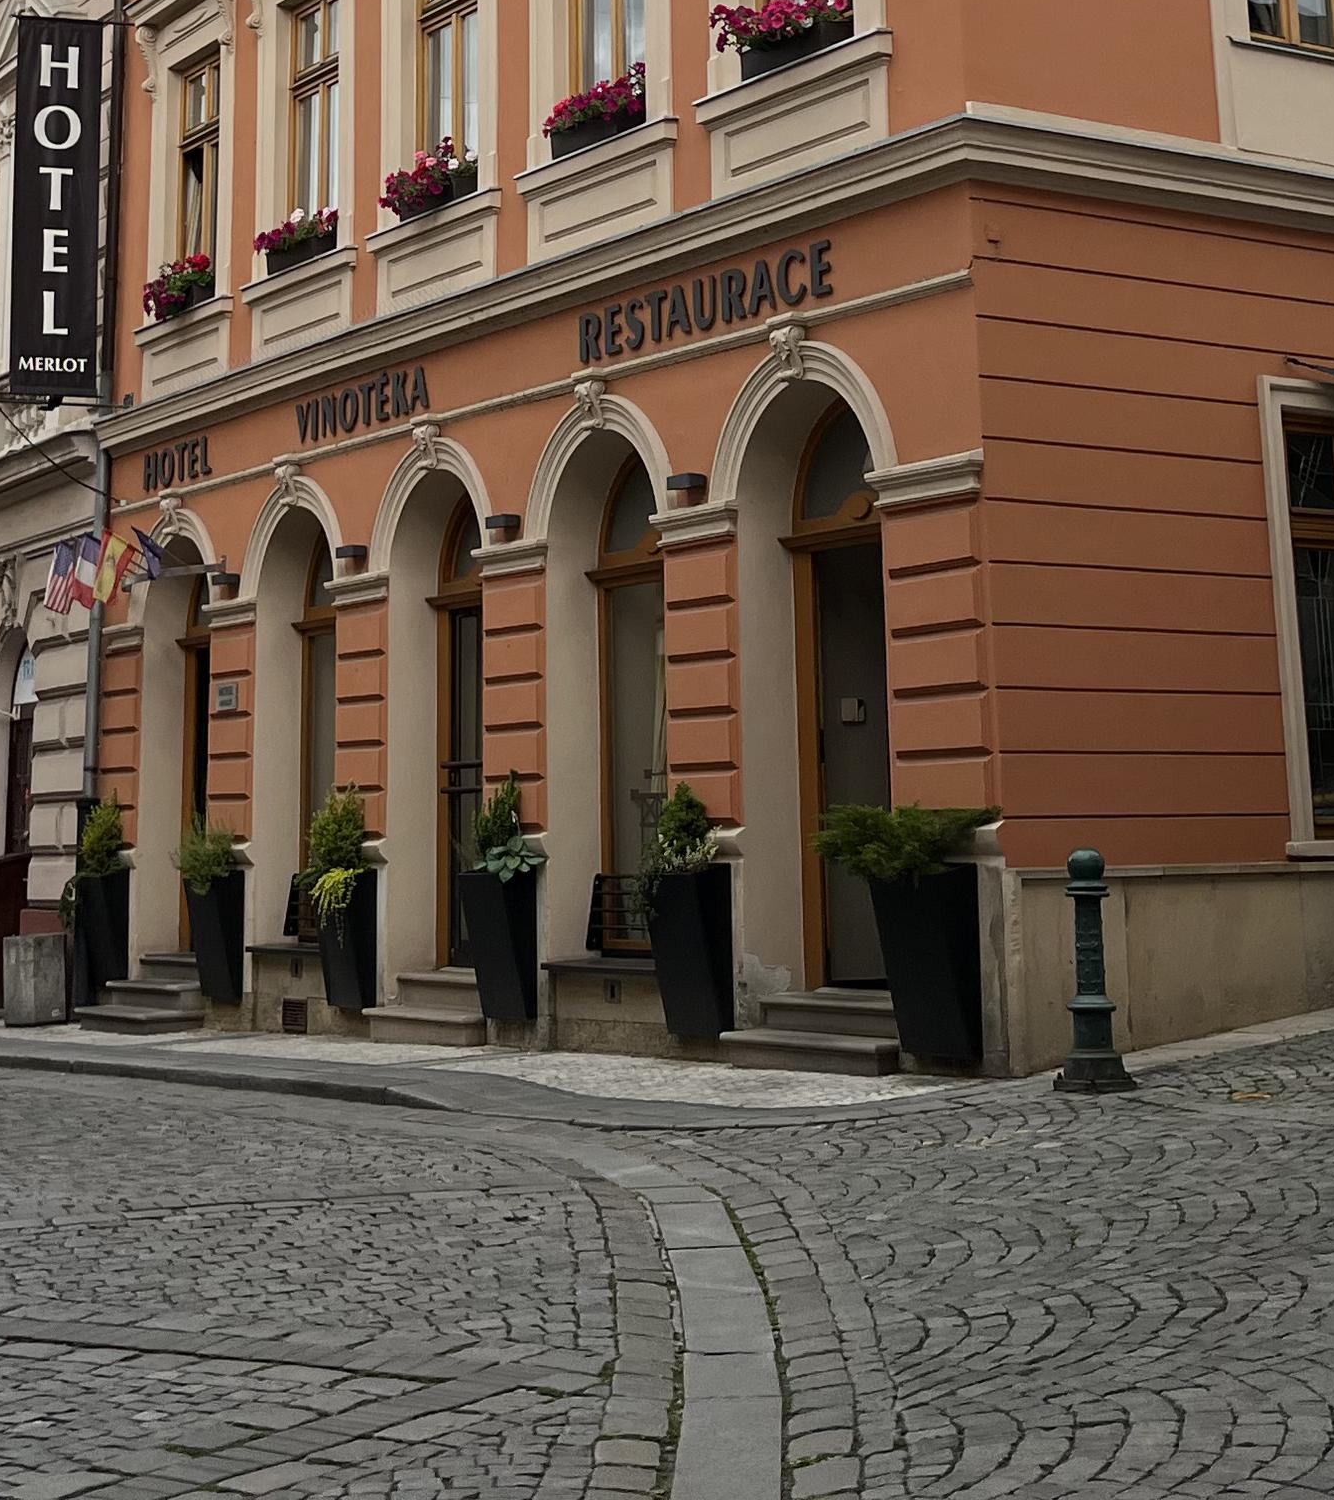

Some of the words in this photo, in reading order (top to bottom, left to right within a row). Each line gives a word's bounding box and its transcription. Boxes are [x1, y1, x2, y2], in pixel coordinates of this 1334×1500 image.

[33, 44, 82, 335] HOTEL
[578, 238, 834, 364] RESTAURACE
[18, 356, 88, 373] MERLOT
[295, 365, 430, 443] VINOTÉKA
[142, 435, 213, 492] HOTEL
